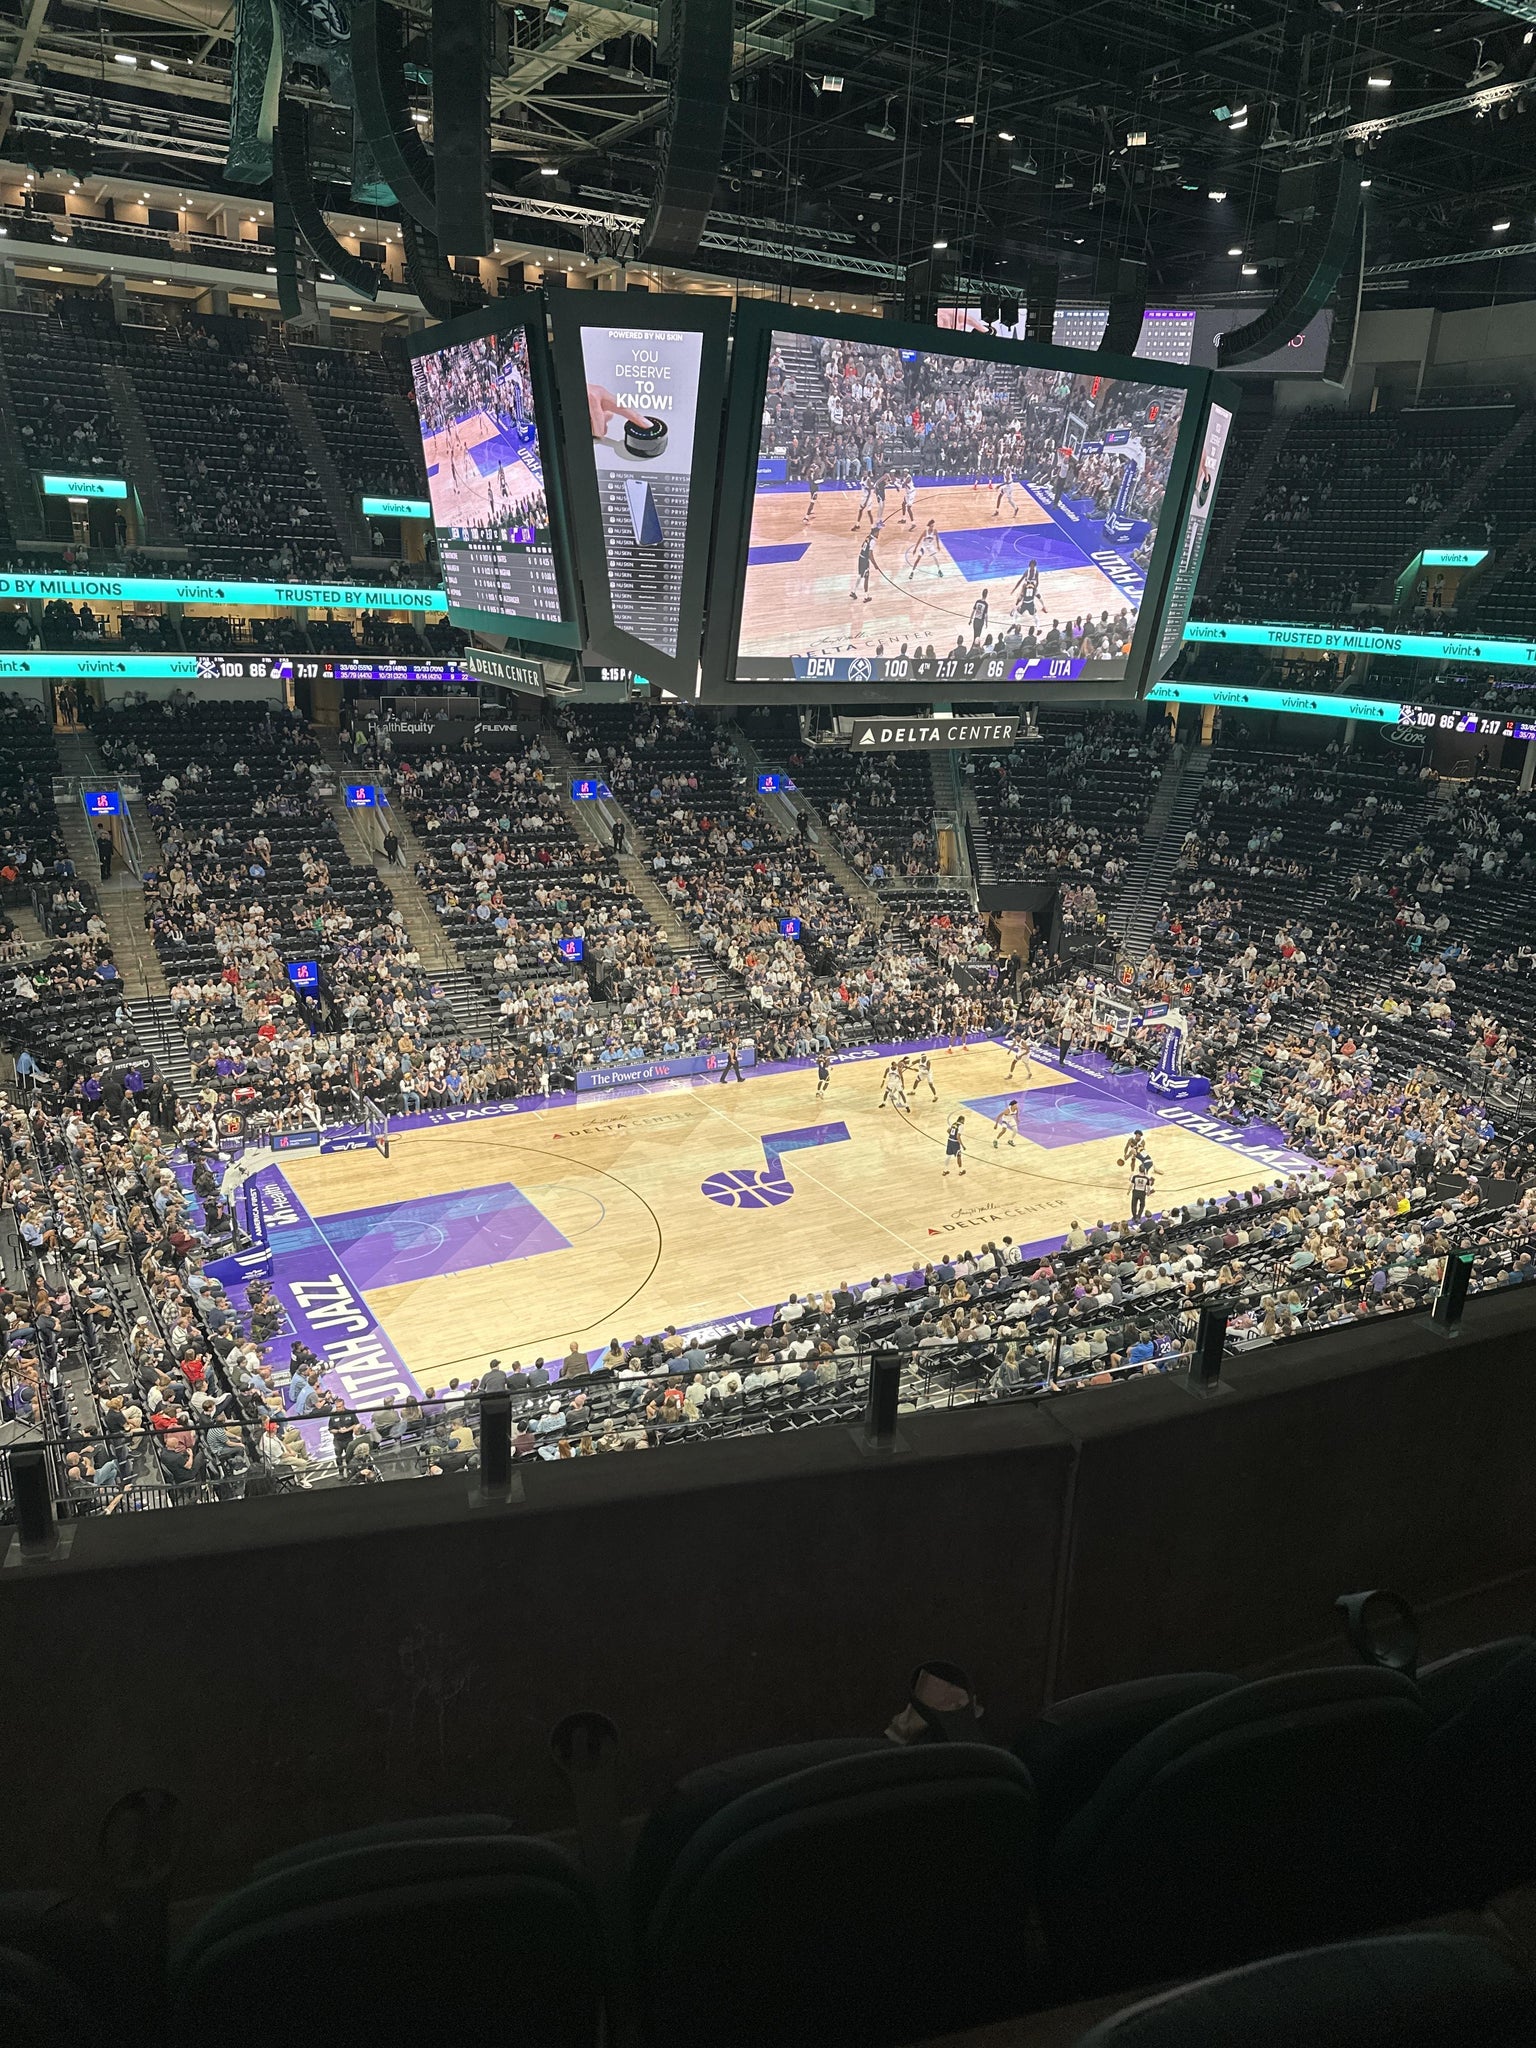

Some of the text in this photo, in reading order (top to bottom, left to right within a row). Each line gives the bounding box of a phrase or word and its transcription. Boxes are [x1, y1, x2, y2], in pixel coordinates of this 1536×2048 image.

[608, 330, 642, 339] POWERED
[632, 350, 658, 363] YOU
[615, 364, 671, 379] DESERVE
[635, 381, 654, 394] TO
[616, 393, 672, 410] KNOW!
[1090, 550, 1143, 588] UTAH
[15, 580, 36, 593] BY
[40, 580, 122, 596] MILLIONS
[275, 588, 433, 607] TRUSTED BY MILLIONS
[1268, 631, 1402, 650] TRUSTED BY MILLIONS
[220, 664, 243, 677] 100
[250, 664, 266, 677] 86
[297, 664, 318, 678] 7:17
[477, 661, 539, 687] DELTA CENTER
[601, 668, 619, 681] 9:15
[807, 658, 1071, 678] DEN 100 4TH 7:17 12 86 UTA
[1417, 712, 1435, 727] 100
[1440, 714, 1455, 729] 86
[1480, 720, 1501, 735] 7:17
[880, 725, 1012, 743] DELTA CENTER
[827, 1050, 880, 1063] PACS
[591, 1066, 670, 1086] The Power of We
[447, 1103, 519, 1121] PACS
[569, 1123, 627, 1137] DELTA
[632, 1112, 694, 1126] CENTER
[1156, 1106, 1245, 1142] UTAH
[265, 1183, 292, 1210] Health
[250, 1188, 262, 1237] AMERICA FIRST
[942, 1215, 1002, 1231] DELTA
[1004, 1199, 1065, 1217] CENTER
[288, 1274, 369, 1333] JAZZ
[322, 1334, 411, 1410] UTAH
